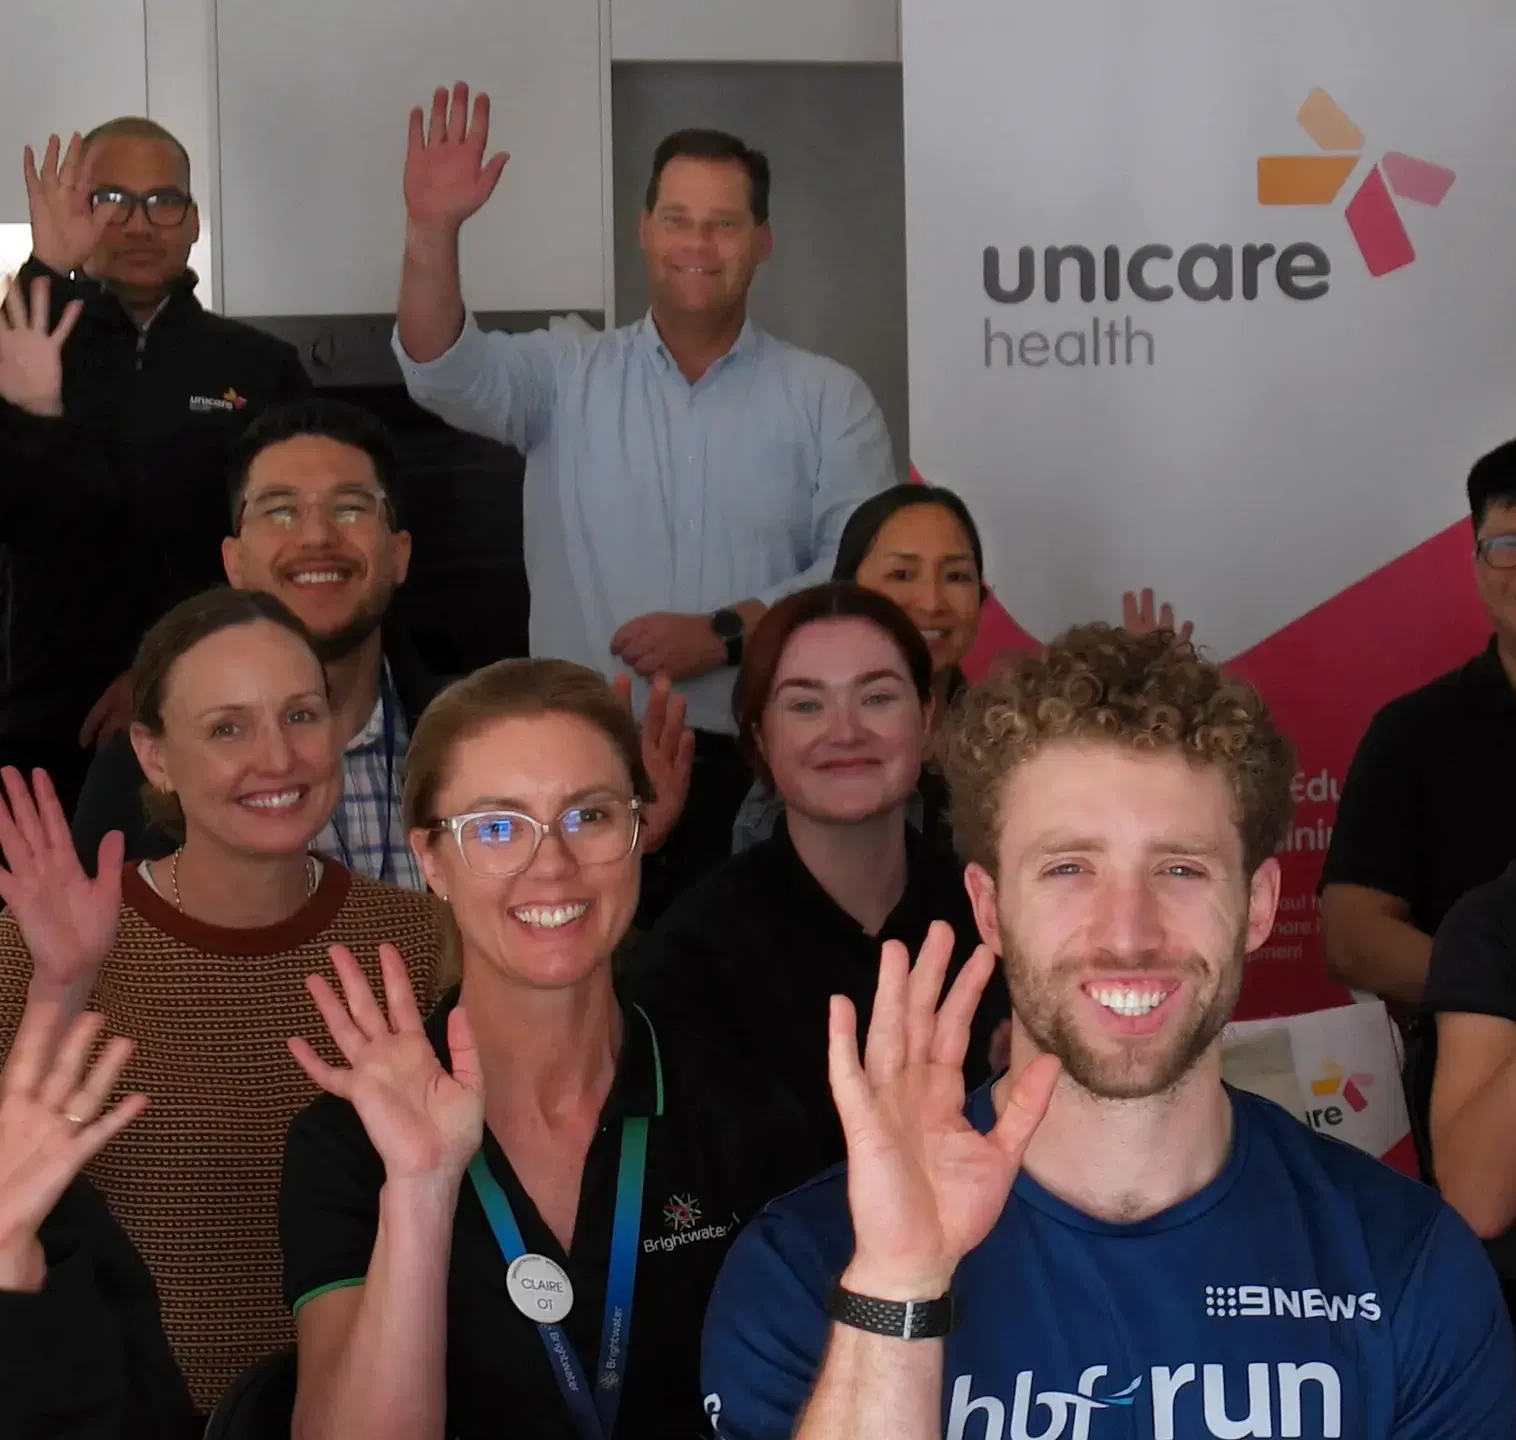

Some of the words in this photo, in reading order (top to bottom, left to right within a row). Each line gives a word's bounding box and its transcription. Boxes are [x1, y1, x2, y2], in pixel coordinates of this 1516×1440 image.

[983, 242, 1332, 304] unicare
[984, 315, 1155, 368] health
[644, 1224, 729, 1253] Brightwater
[521, 1278, 564, 1293] CLAIRE
[537, 1298, 553, 1311] OT
[1151, 1362, 1342, 1440] run
